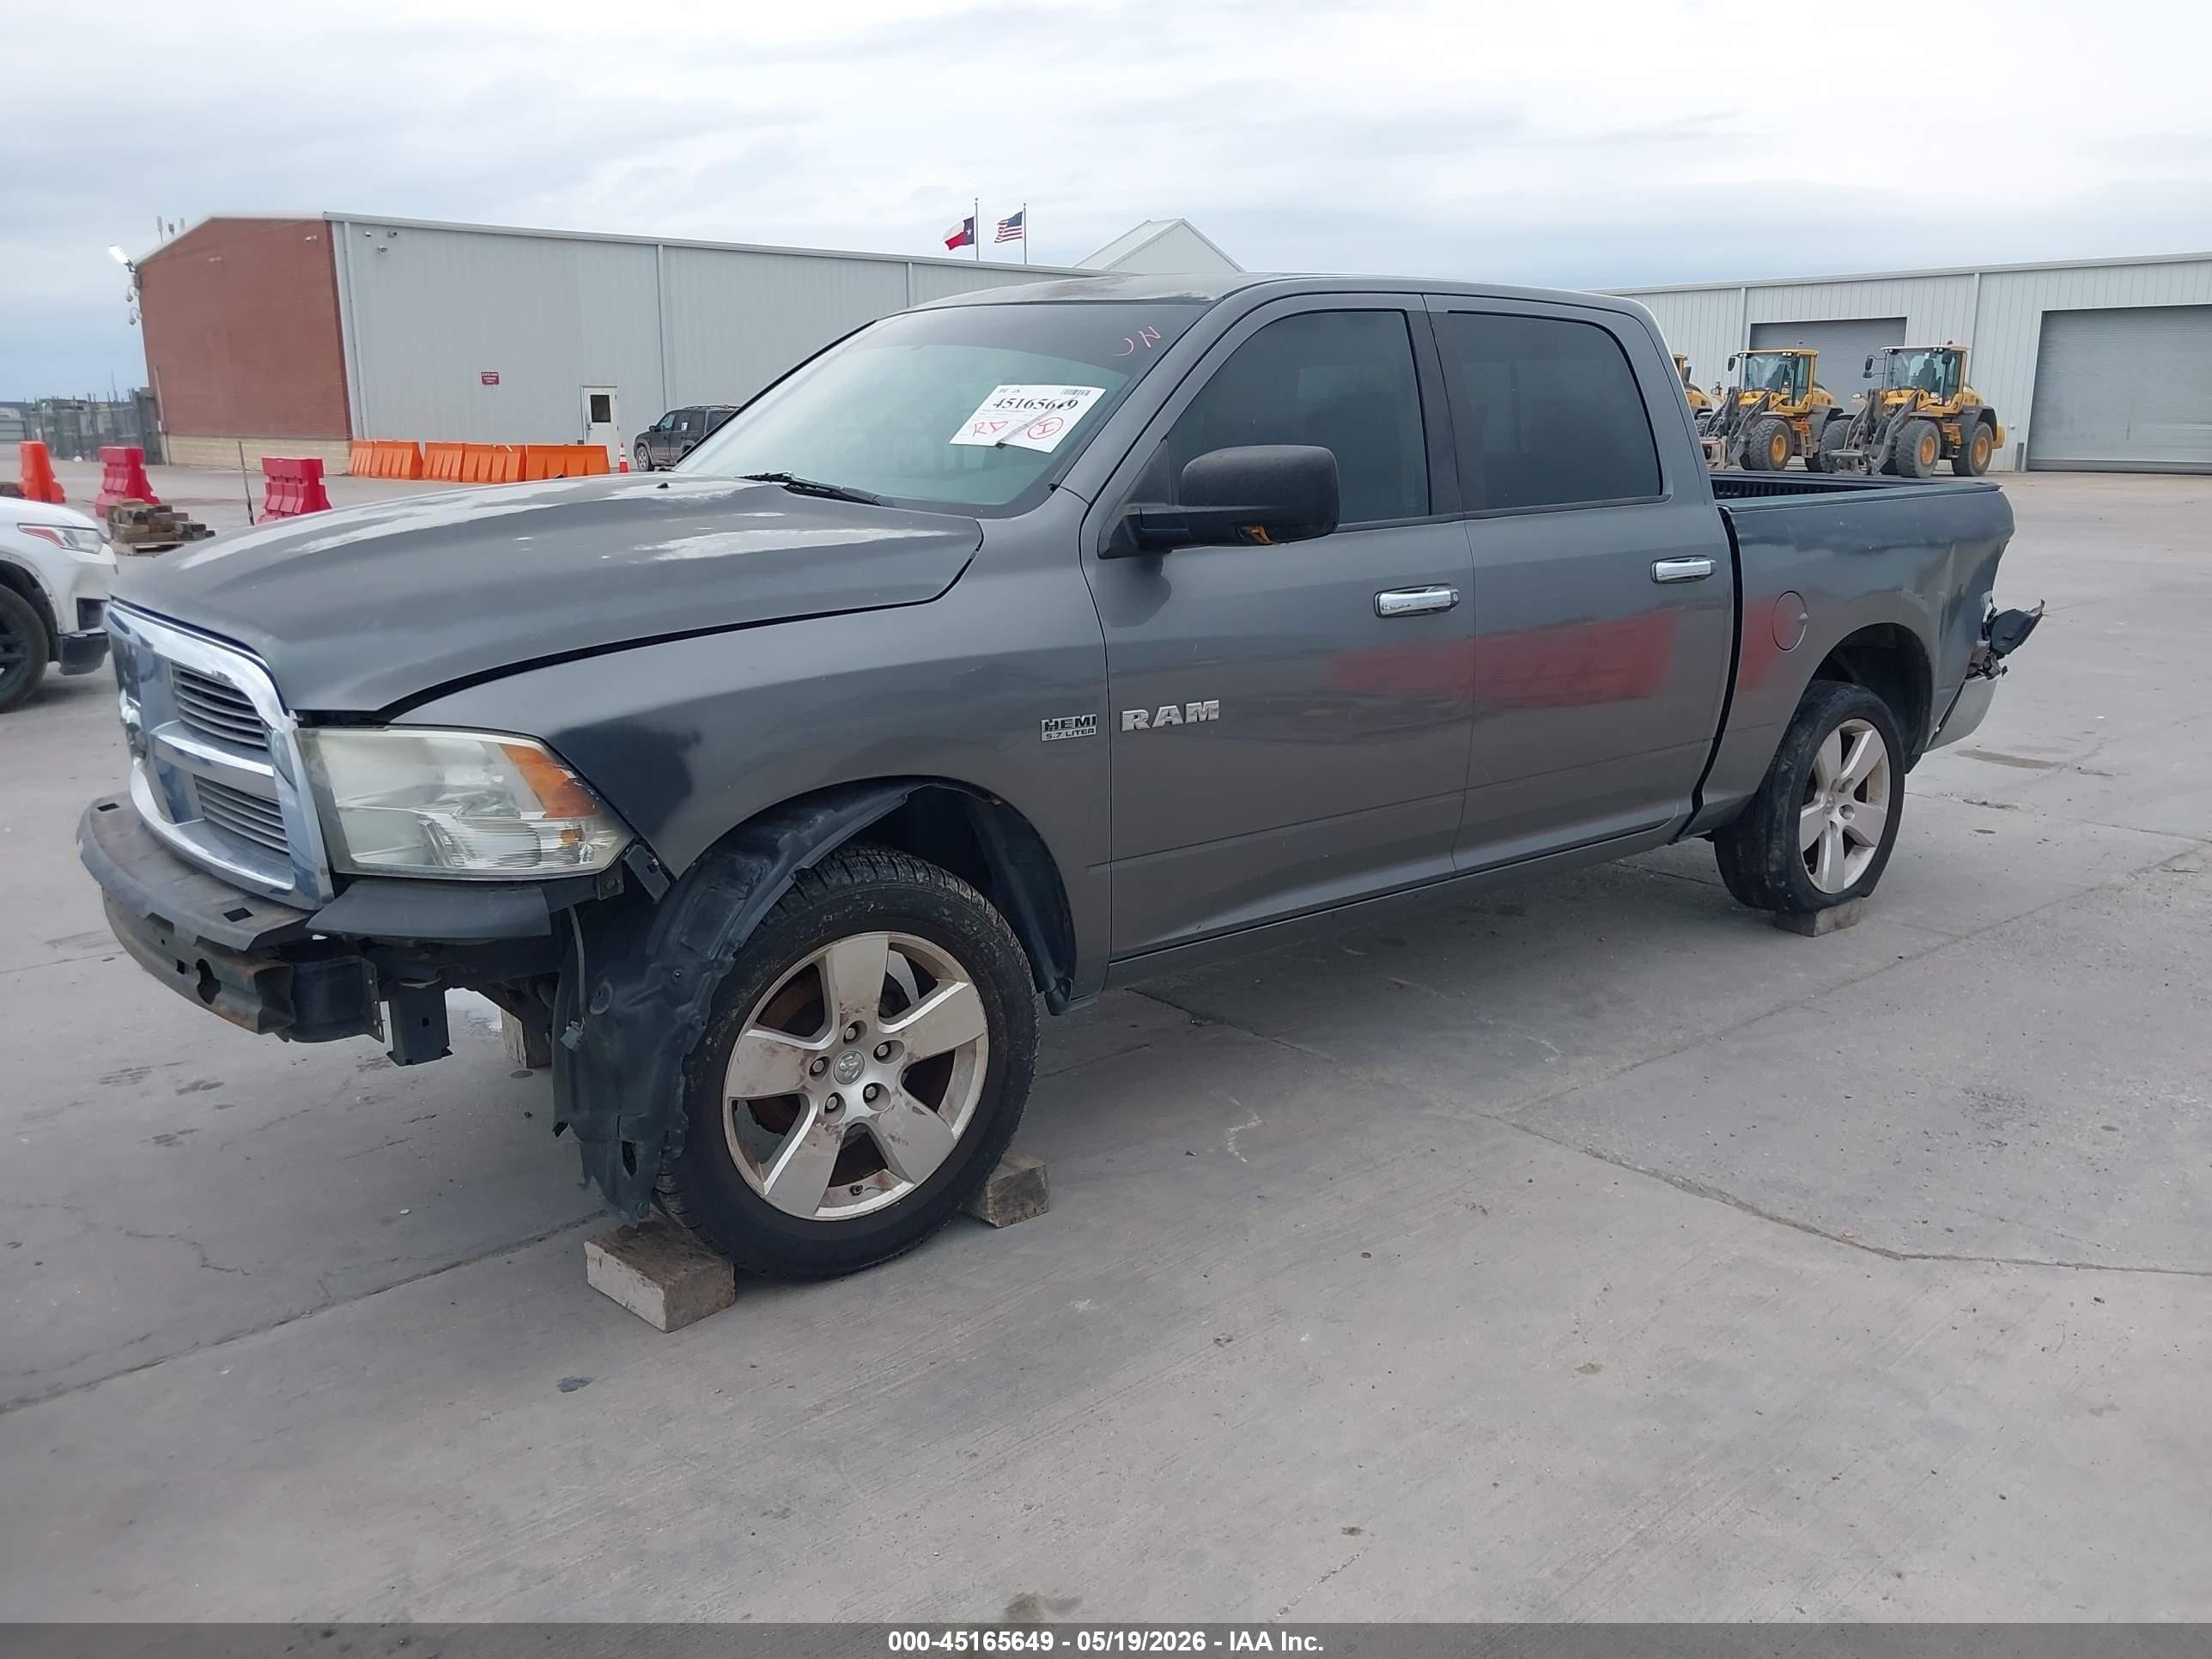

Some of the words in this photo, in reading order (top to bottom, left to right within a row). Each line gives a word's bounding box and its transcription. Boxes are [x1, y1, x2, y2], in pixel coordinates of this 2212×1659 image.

[1043, 714, 1097, 732] HEMI
[1120, 699, 1220, 732] RAM
[1045, 732, 1062, 740] 5.7
[1065, 727, 1095, 738] LITER
